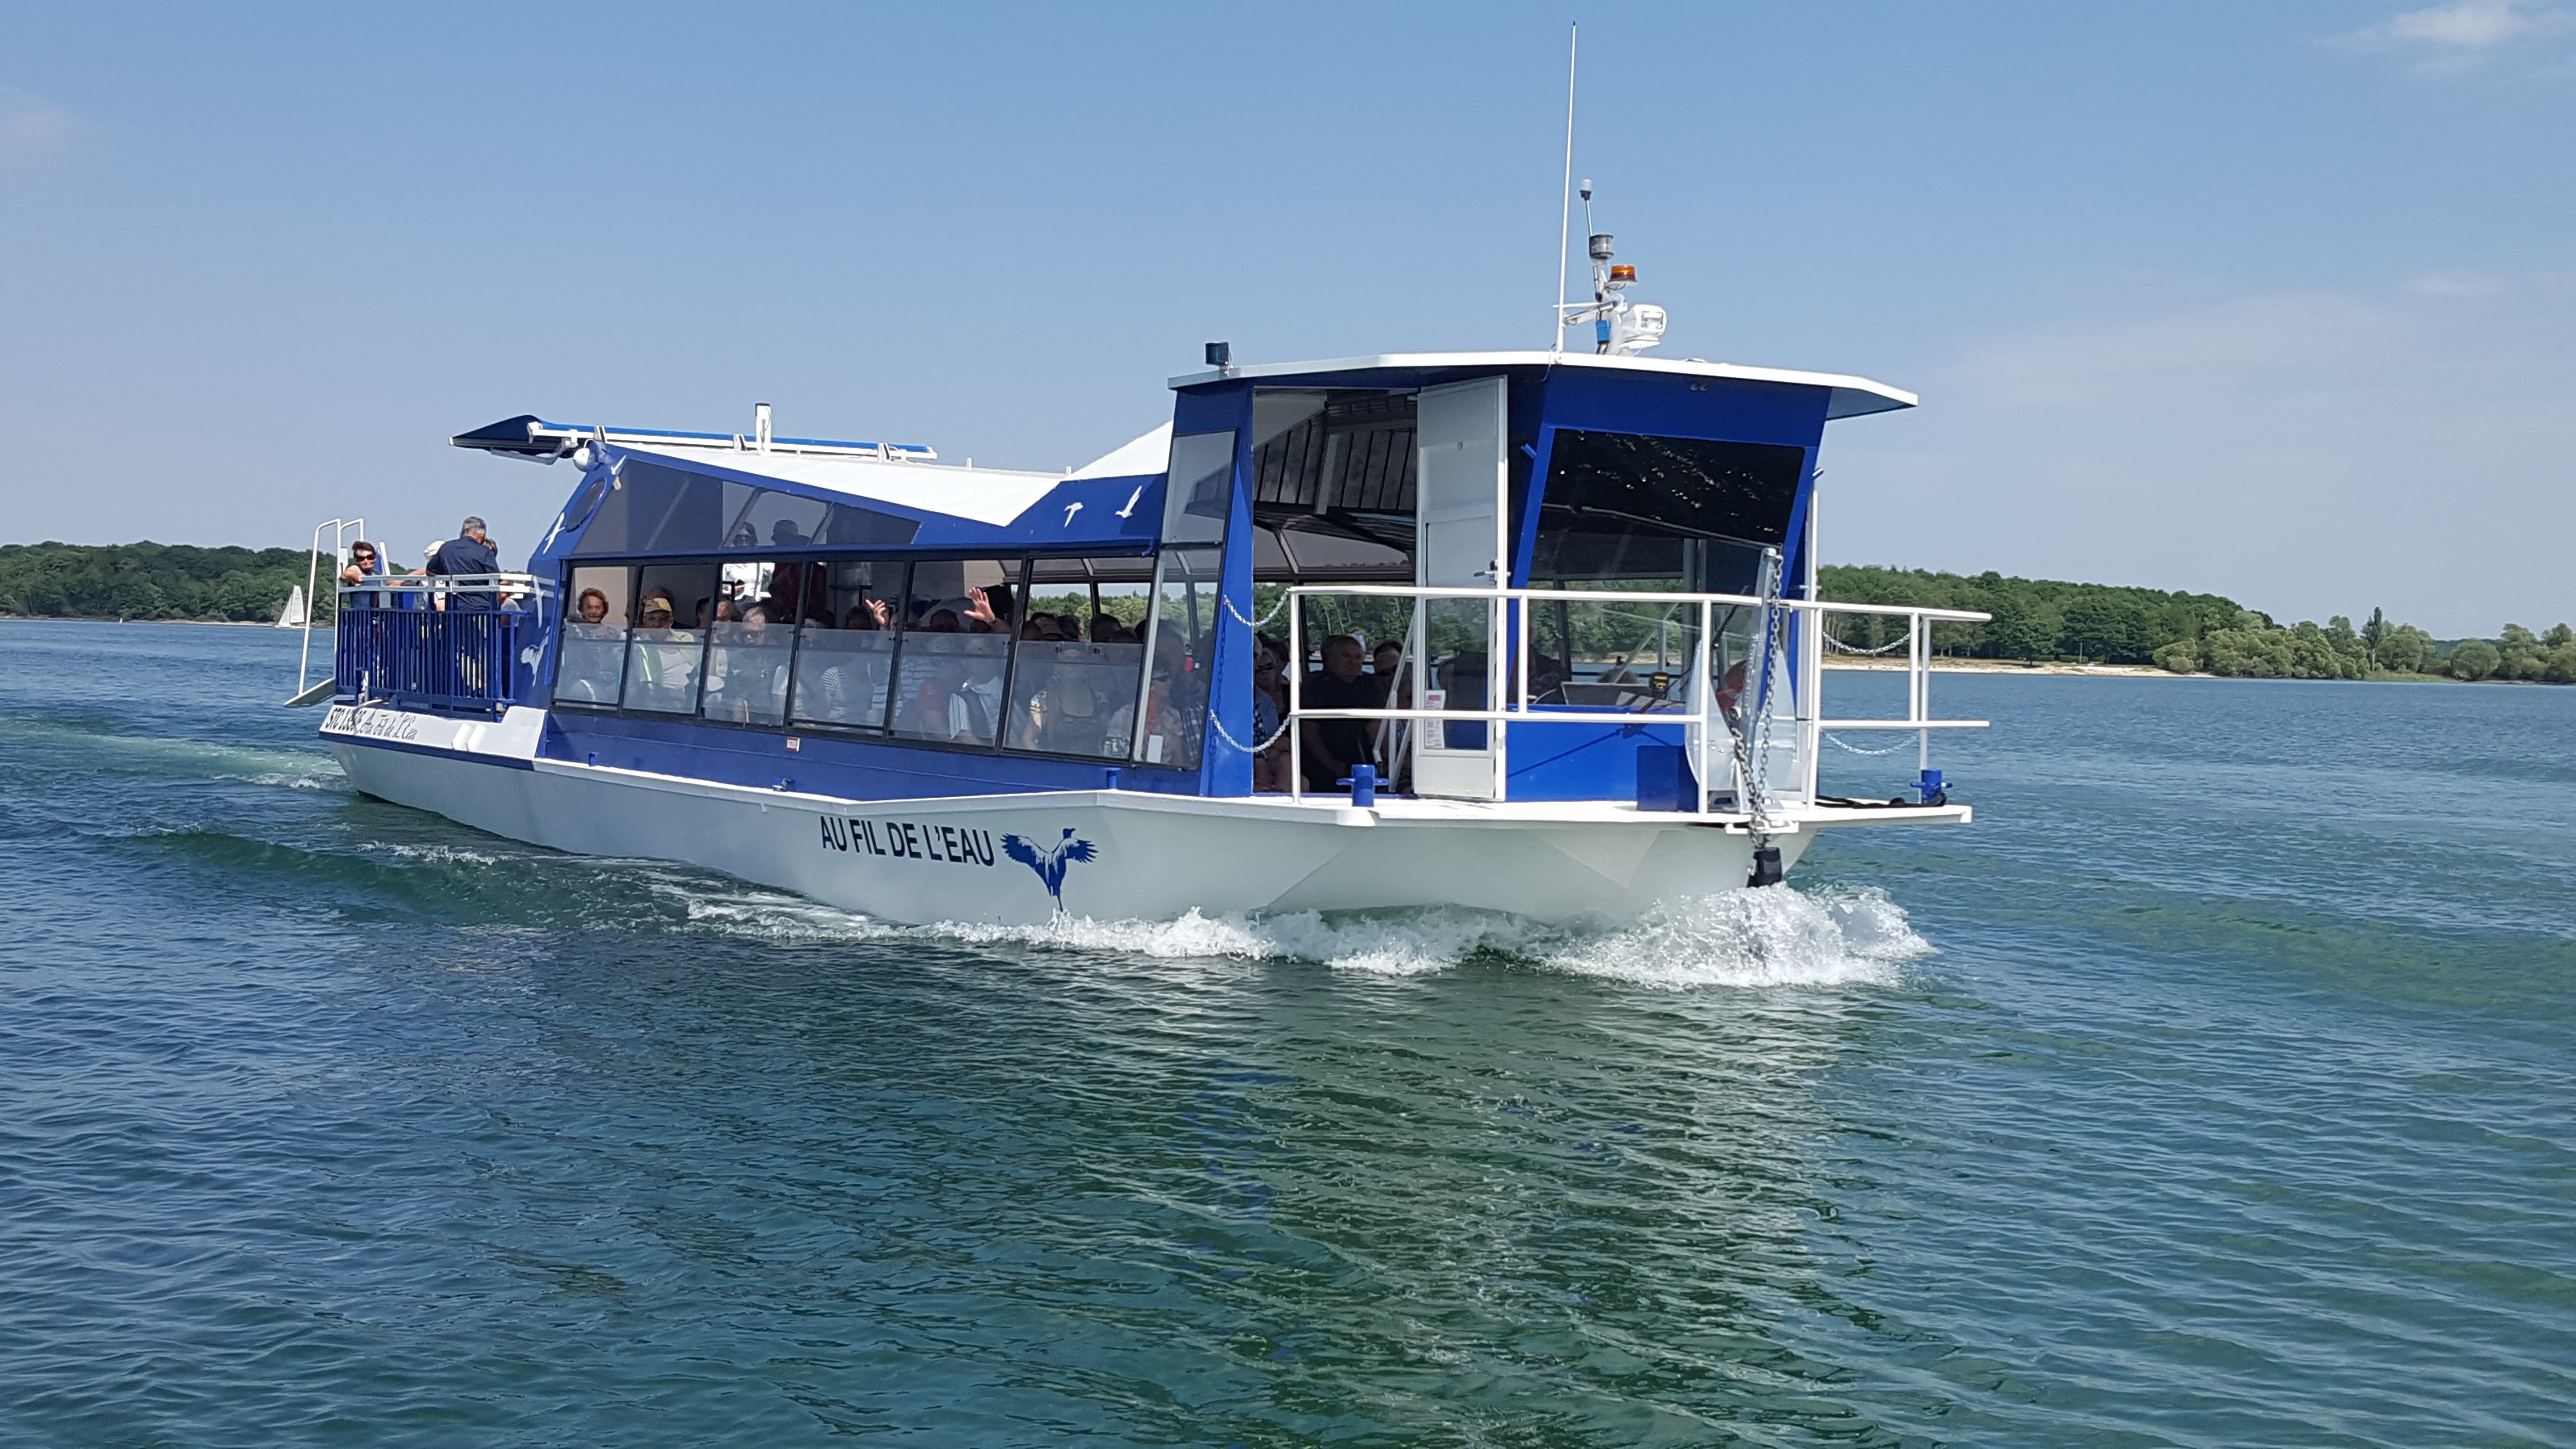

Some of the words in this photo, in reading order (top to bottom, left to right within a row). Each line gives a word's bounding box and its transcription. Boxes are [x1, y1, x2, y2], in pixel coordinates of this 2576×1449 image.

[820, 816, 847, 852] AU
[848, 819, 886, 855] FIL
[886, 822, 922, 859] DE
[922, 824, 995, 867] L'EAU
